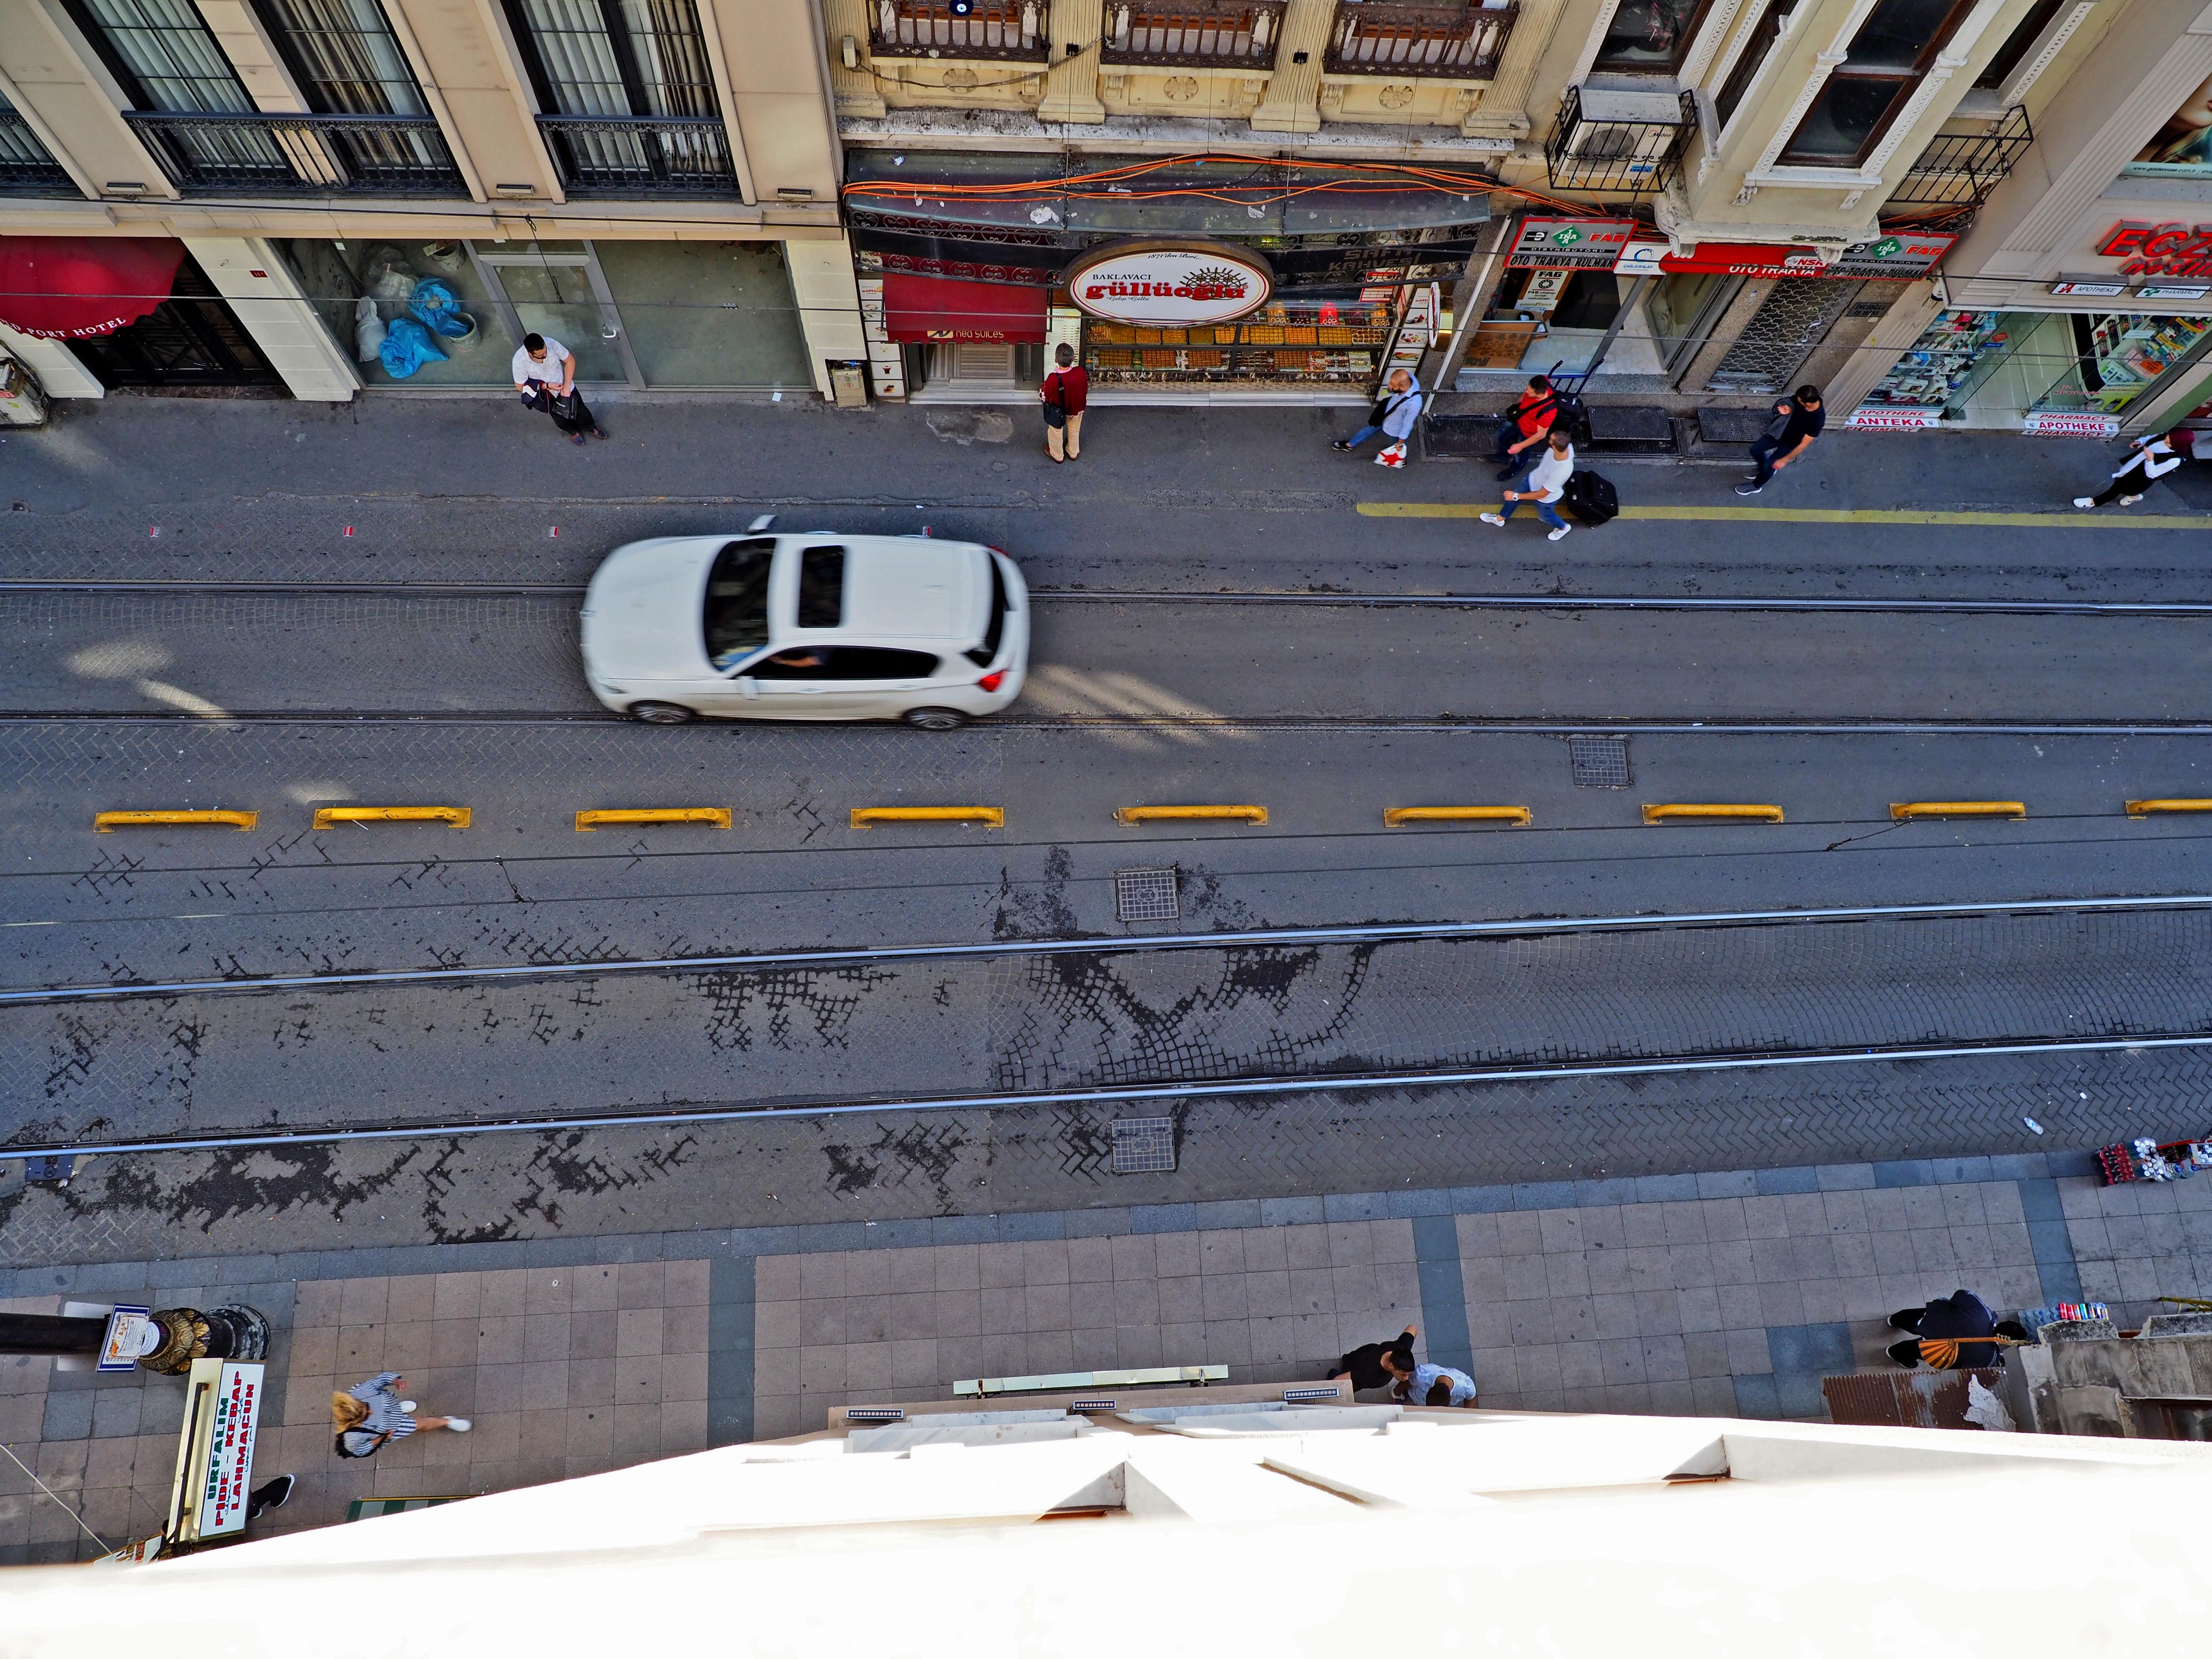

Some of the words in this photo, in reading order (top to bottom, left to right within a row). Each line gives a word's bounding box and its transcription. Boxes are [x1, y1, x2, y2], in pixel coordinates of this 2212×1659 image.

[1589, 233, 1626, 242] FAG
[2096, 224, 2212, 258] ECZ
[1905, 245, 1944, 255] FAG
[1510, 256, 1530, 266] OTO
[1532, 256, 1572, 267] TRAKYA
[1574, 257, 1615, 268] RULMAN
[1085, 281, 1245, 300] güllüoğlu
[26, 327, 66, 337] PORT
[73, 317, 126, 336] HOTEL
[1857, 418, 1925, 426] ANTEKA
[2039, 422, 2106, 431] APOTHEKE
[225, 1371, 242, 1447] KEBAP
[207, 1398, 229, 1499] URFALIM
[231, 1384, 254, 1510] LAHMACUN
